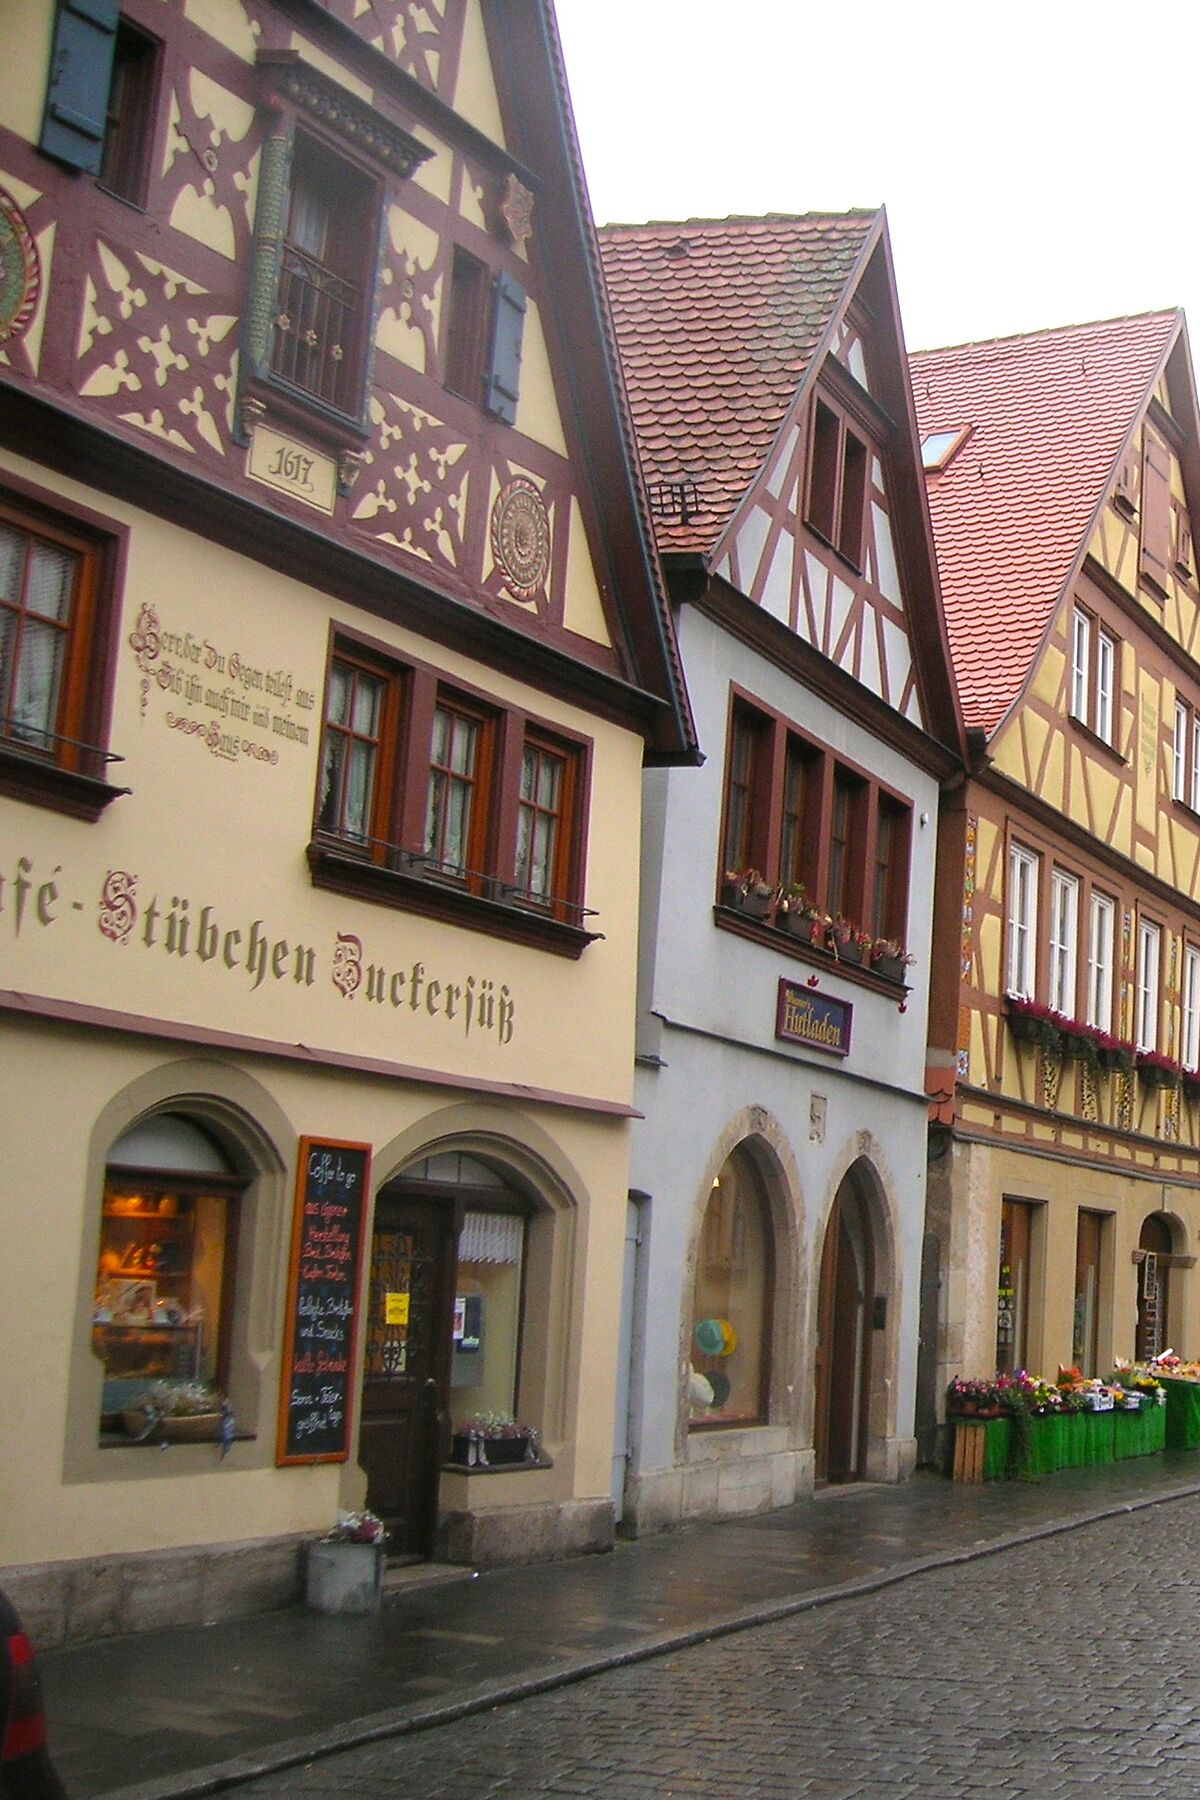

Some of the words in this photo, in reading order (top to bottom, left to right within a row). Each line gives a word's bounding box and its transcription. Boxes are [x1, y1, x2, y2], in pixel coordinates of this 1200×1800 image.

[268, 447, 314, 484] 1617
[203, 638, 226, 675] Du
[296, 688, 316, 711] aus
[0, 855, 62, 939] fé
[100, 869, 317, 992] Stübchen
[332, 931, 515, 1047] Zuckersüß
[783, 1003, 841, 1046] Hutladen
[308, 1152, 335, 1185] Coffee
[337, 1156, 345, 1182] to
[346, 1172, 356, 1189] go
